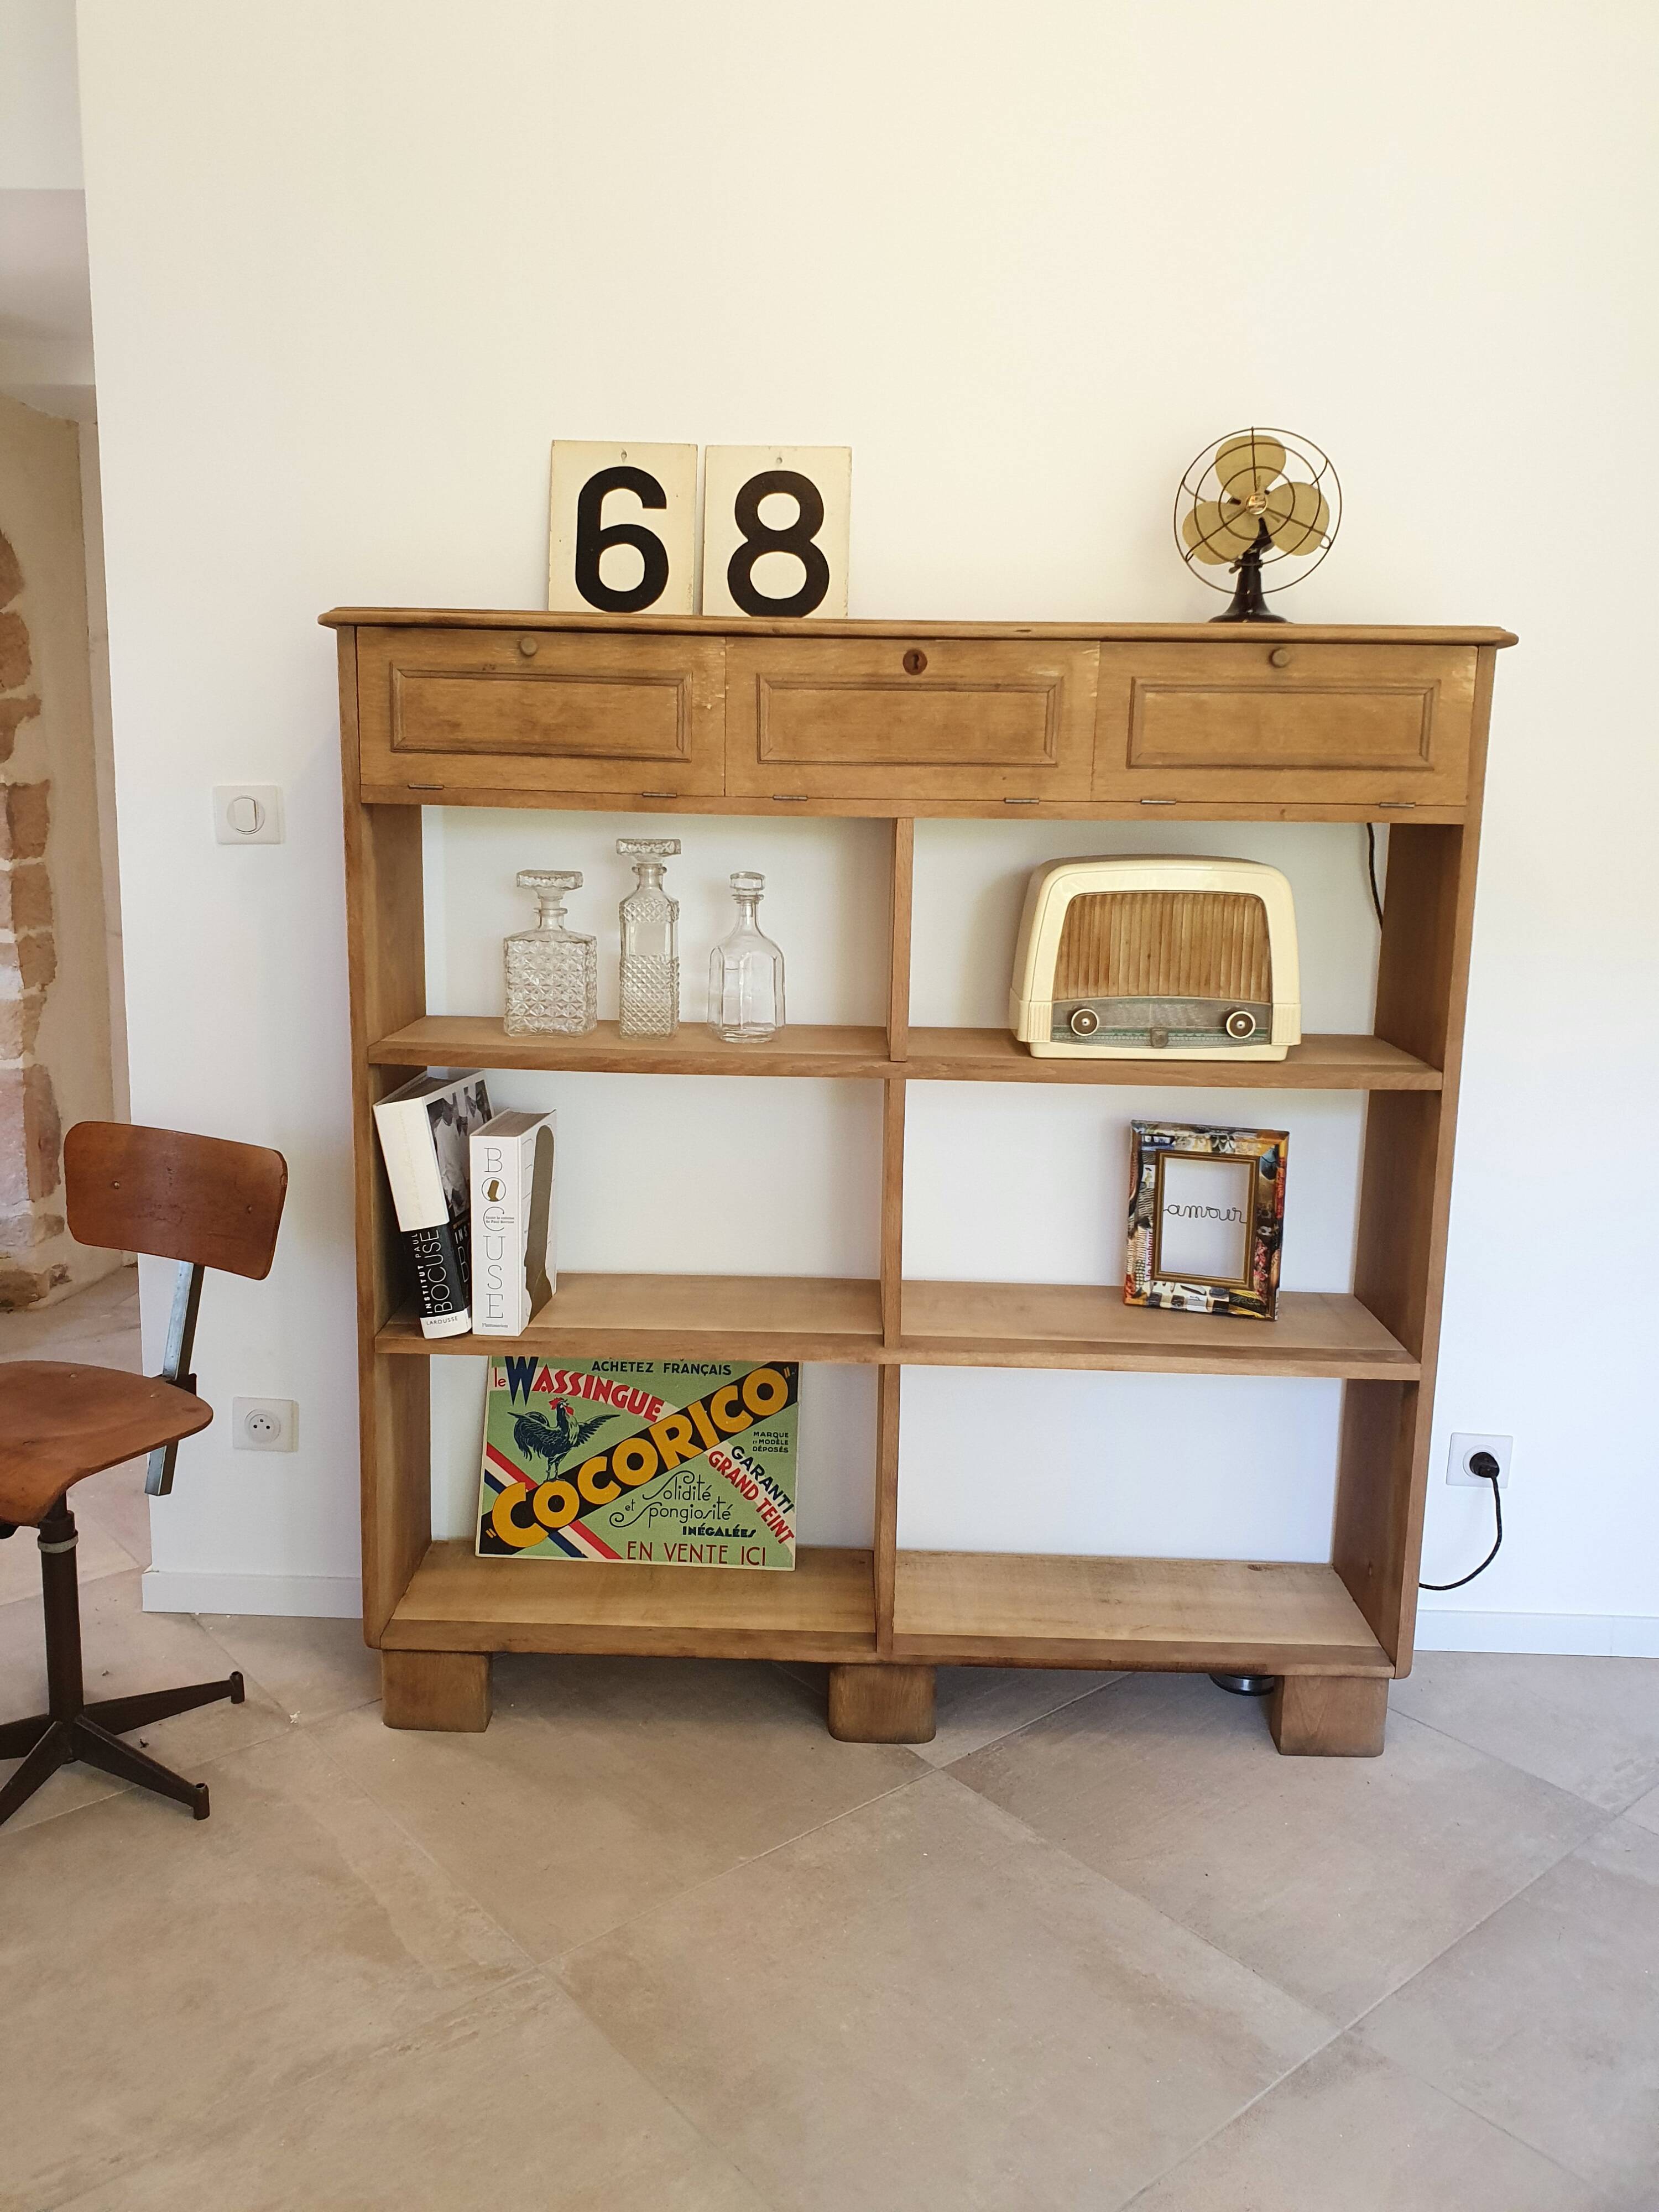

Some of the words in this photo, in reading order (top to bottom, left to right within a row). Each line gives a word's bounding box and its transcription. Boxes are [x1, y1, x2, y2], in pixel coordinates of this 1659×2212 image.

[575, 466, 669, 613] 6
[727, 470, 830, 618] 8
[1163, 1204, 1247, 1223] amour
[411, 1233, 421, 1258] PAUL
[481, 1147, 507, 1318] BOCUSE
[419, 1229, 453, 1313] BOCUSE
[418, 1265, 433, 1314] INSTITUT
[426, 1316, 458, 1326] LAROUSSE
[592, 1361, 654, 1373] ACHETEZ
[664, 1362, 732, 1376] FRANÇAIS
[494, 1368, 506, 1387] le
[505, 1357, 665, 1422] WASSINGUE
[753, 1431, 789, 1440] MARQUE
[642, 1470, 712, 1501] Solidité
[731, 1446, 795, 1514] GARANTI
[609, 1496, 733, 1528] Spongiosité
[625, 1499, 635, 1511] et
[708, 1451, 759, 1500] GRAND
[756, 1498, 795, 1544] TEINT
[682, 1522, 757, 1538] INÉGALÉES
[627, 1541, 653, 1562] EN
[664, 1542, 728, 1564] VENTE
[741, 1546, 765, 1566] ICI
